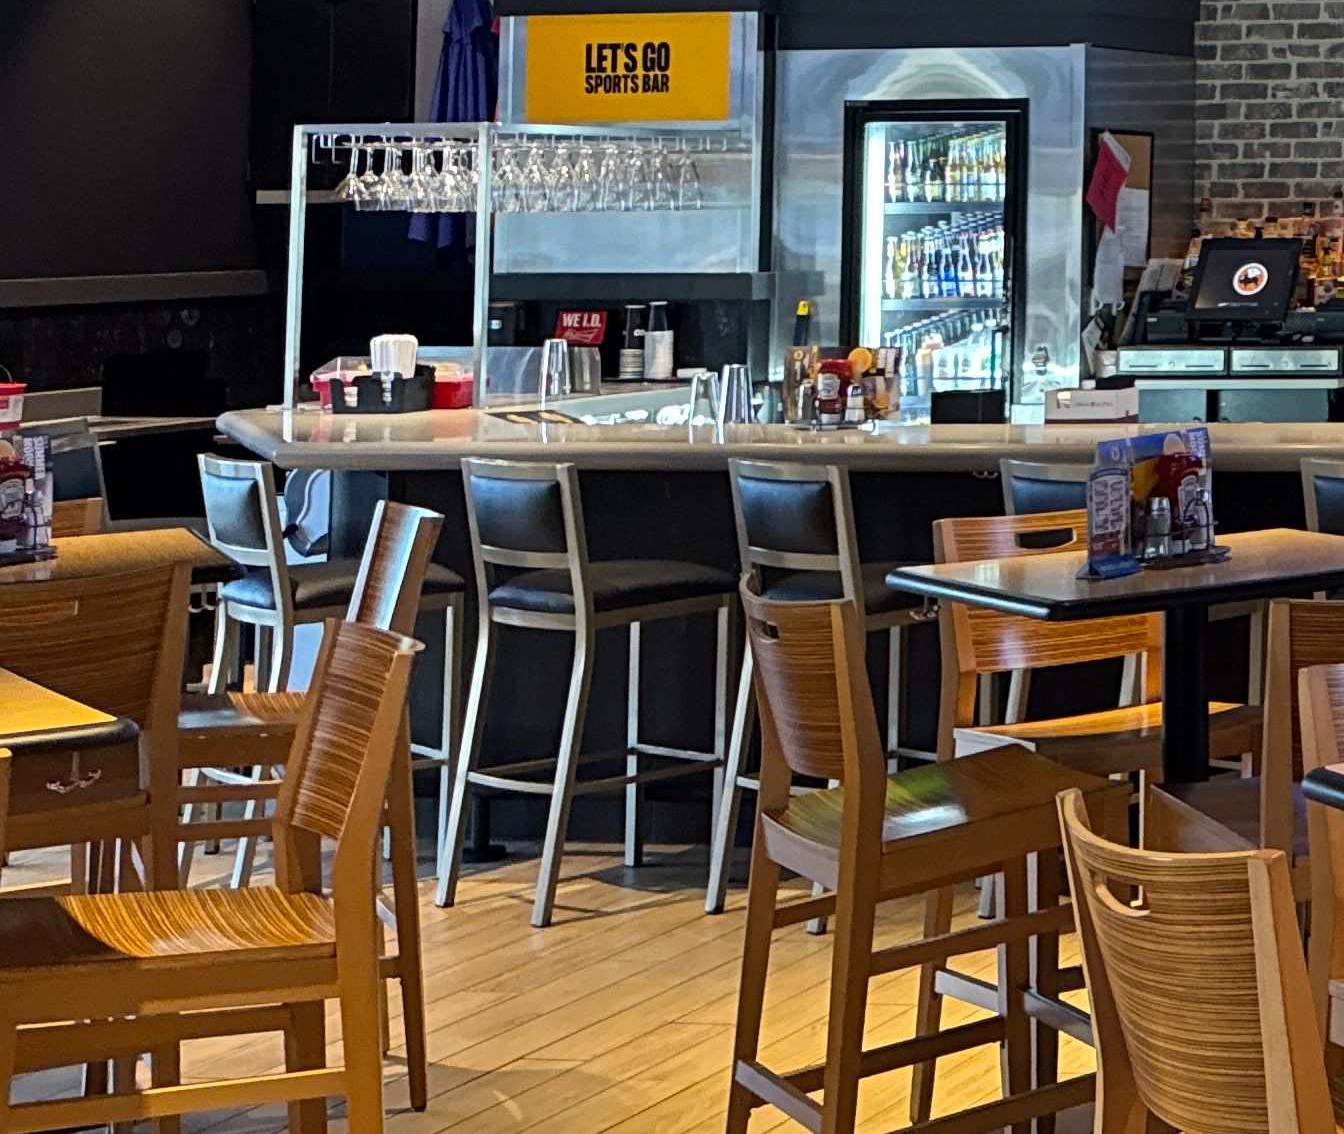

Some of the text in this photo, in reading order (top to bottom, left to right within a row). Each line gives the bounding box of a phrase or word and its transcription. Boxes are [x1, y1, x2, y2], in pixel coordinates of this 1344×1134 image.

[585, 41, 670, 74] LET'S GO
[585, 74, 670, 94] SPORTS BAR
[563, 314, 581, 327] WE
